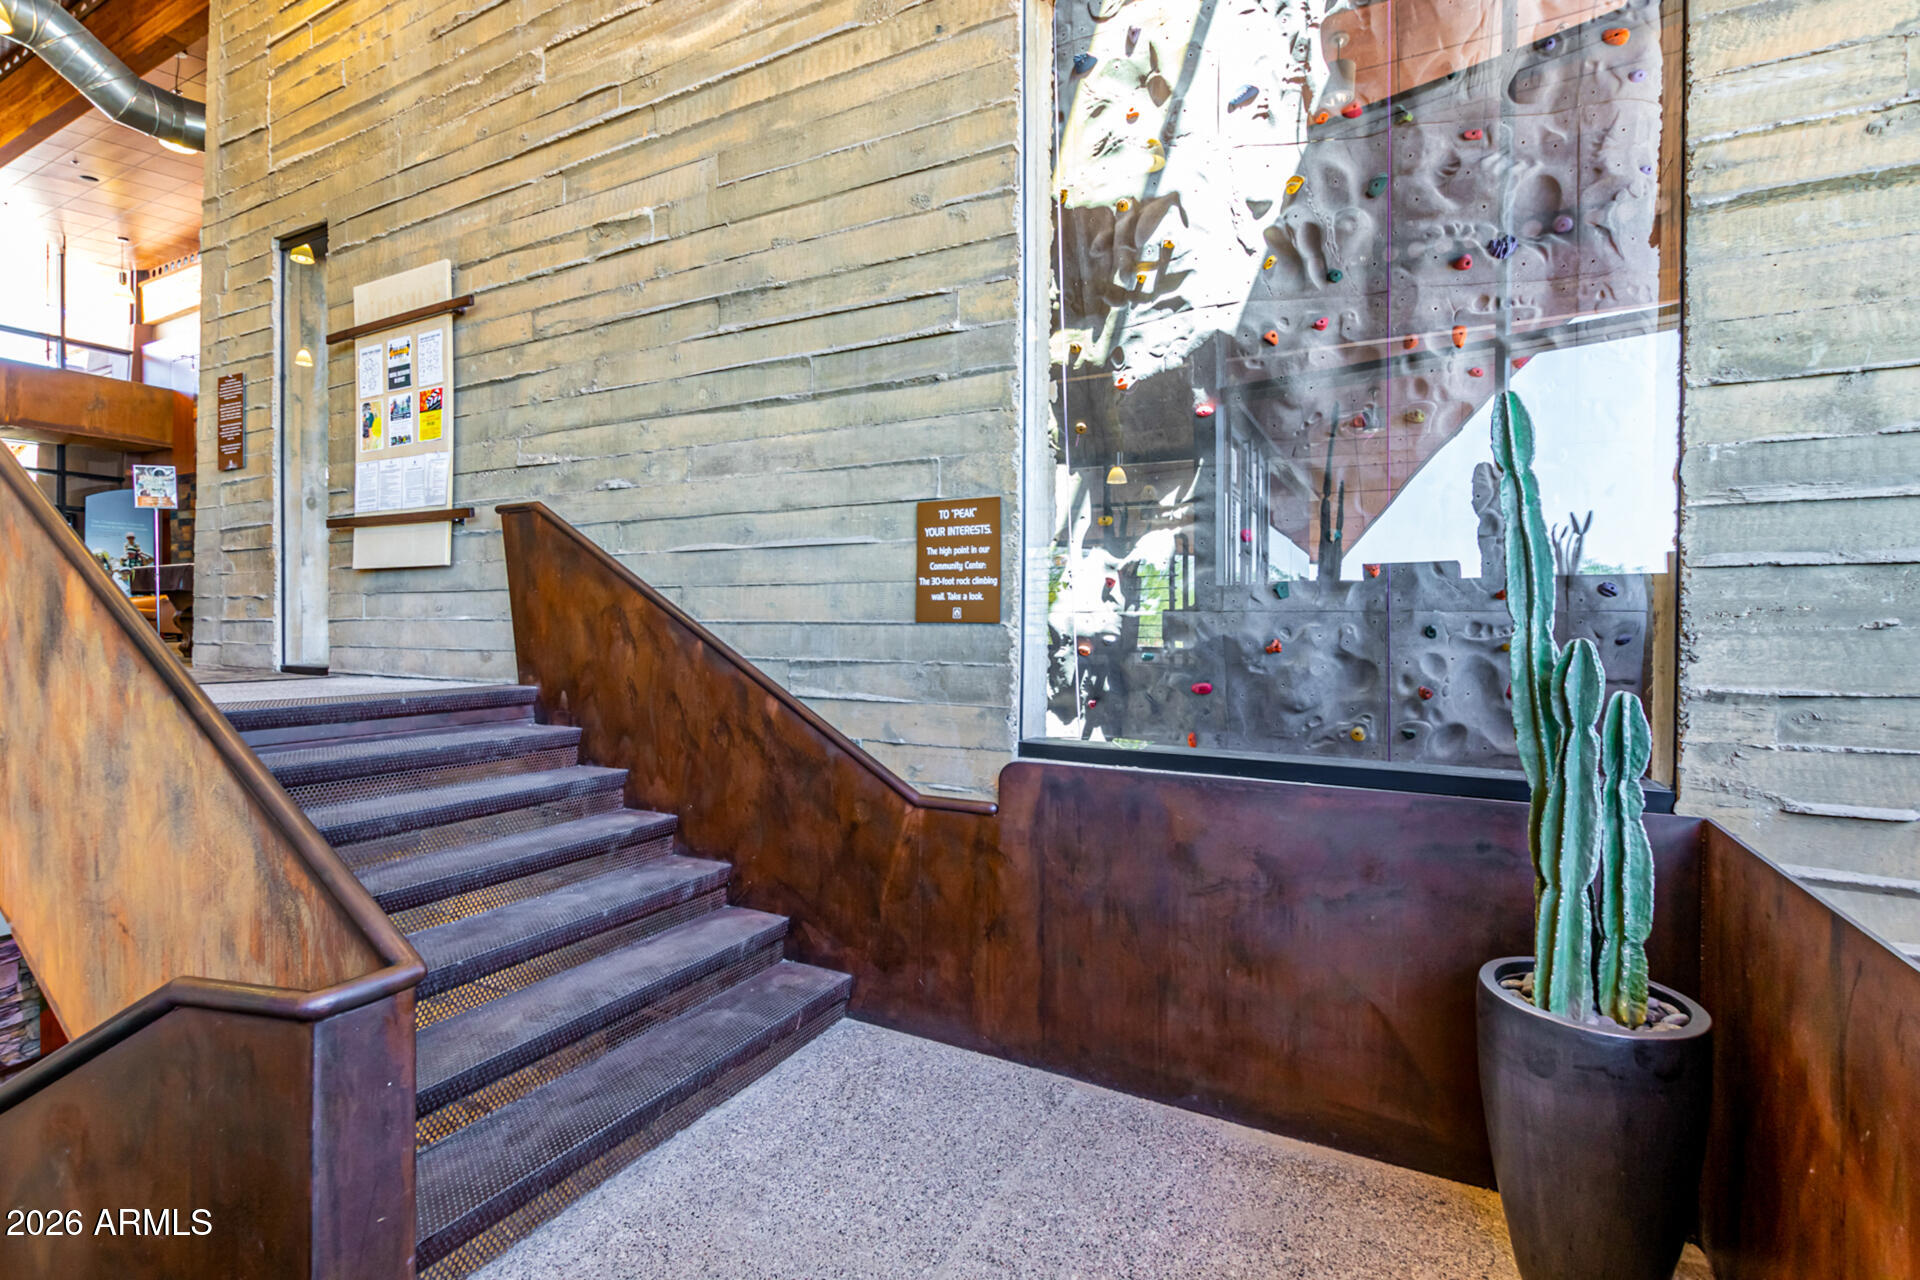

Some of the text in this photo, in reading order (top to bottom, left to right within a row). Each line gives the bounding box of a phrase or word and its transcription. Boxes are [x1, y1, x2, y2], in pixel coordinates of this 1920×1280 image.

[938, 510, 949, 519] TO
[924, 524, 992, 536] YOUR INTERESTS.
[926, 547, 937, 555] The
[938, 547, 952, 556] high
[954, 546, 969, 556] point
[970, 545, 977, 553] in
[930, 562, 963, 571] Community
[930, 577, 954, 585] 30-foot
[956, 577, 970, 585] rock
[972, 576, 998, 586] climbing
[946, 592, 961, 600] Take
[968, 592, 984, 600] look.
